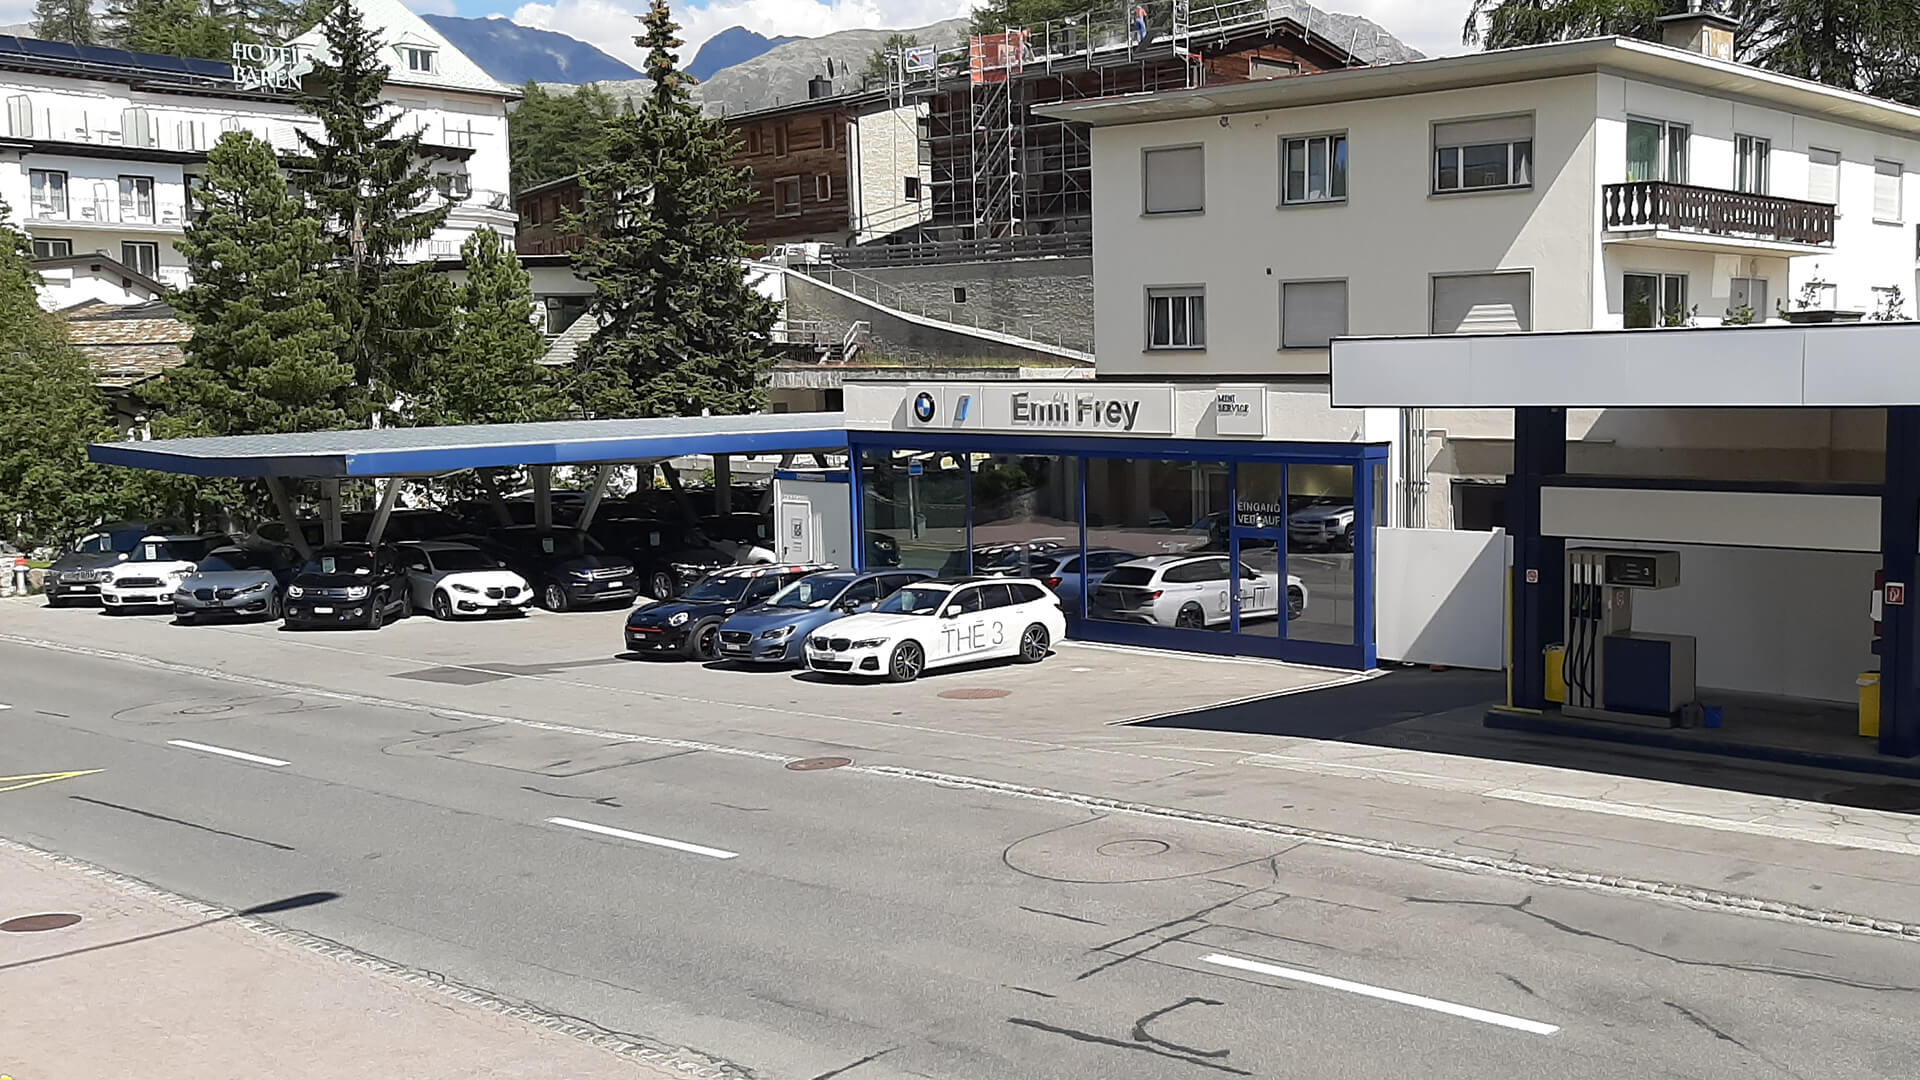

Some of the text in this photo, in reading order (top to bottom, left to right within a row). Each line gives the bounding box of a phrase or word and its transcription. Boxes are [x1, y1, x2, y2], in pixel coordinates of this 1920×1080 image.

[1012, 391, 1069, 423] Emil
[1076, 391, 1140, 431] Frey
[1237, 502, 1281, 513] EINGANG
[1237, 513, 1281, 526] VERAUF
[941, 621, 1004, 653] THE 3
